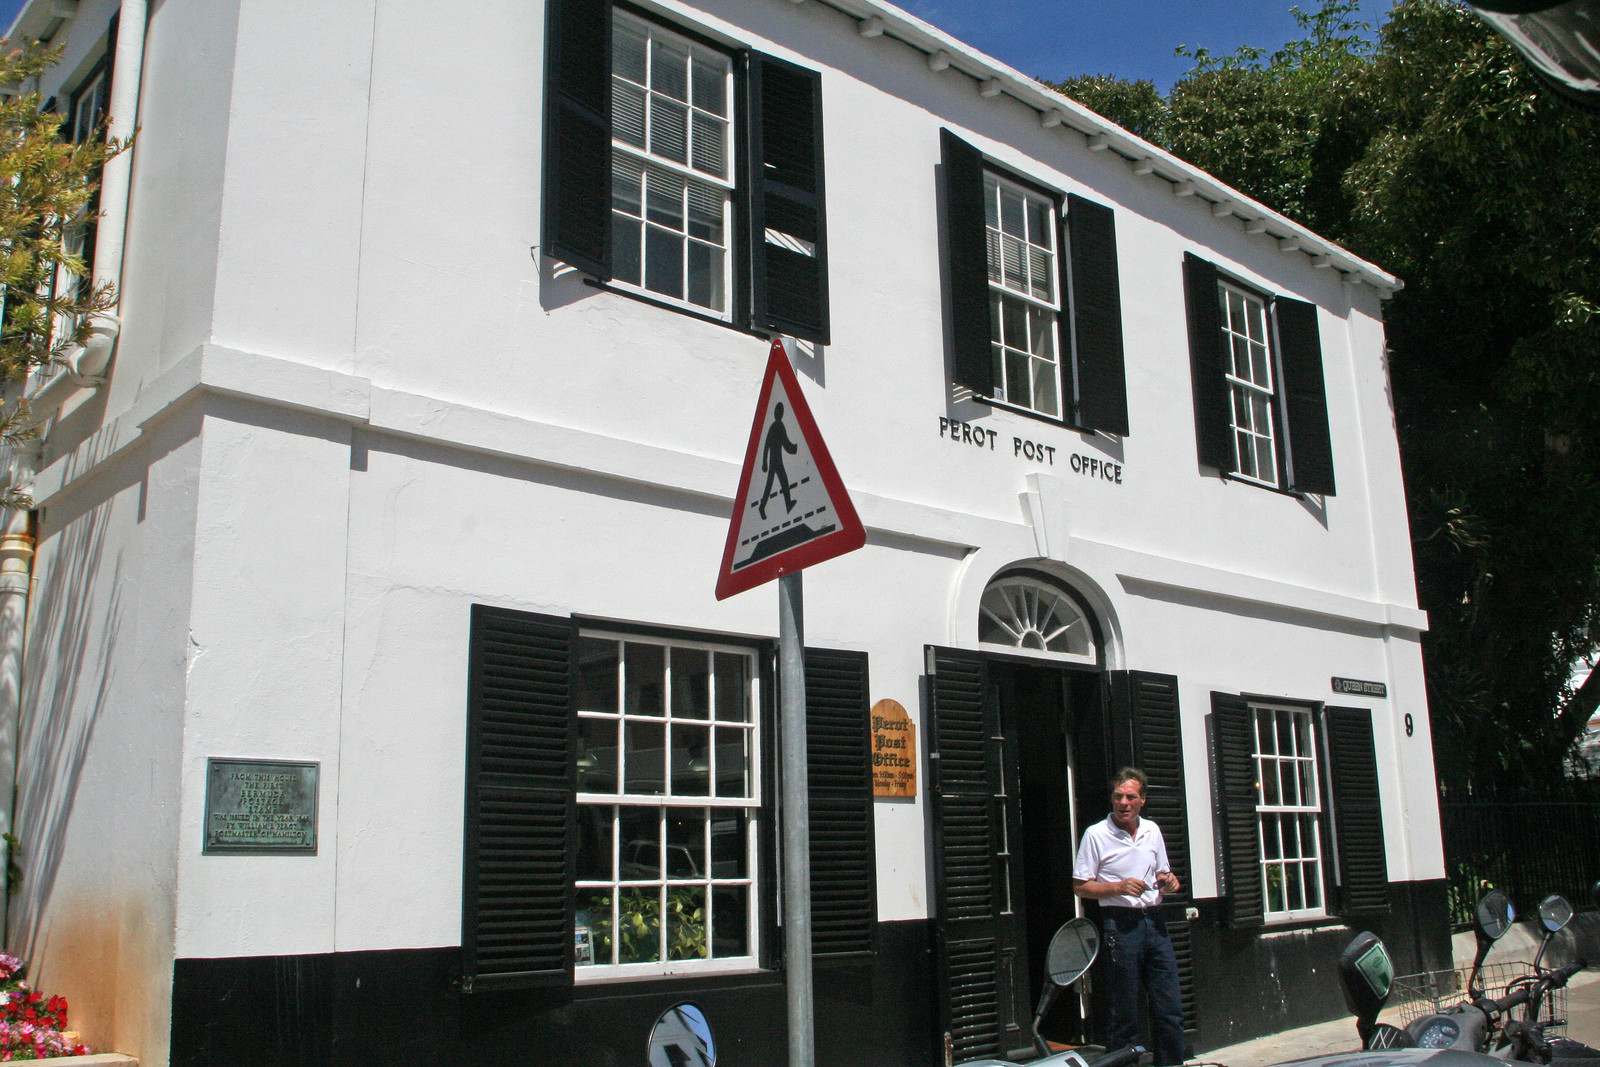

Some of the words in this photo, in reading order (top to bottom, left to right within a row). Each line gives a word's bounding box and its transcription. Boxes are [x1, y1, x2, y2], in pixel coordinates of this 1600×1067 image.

[939, 416, 998, 451] PEROT
[1012, 437, 1056, 466] POST
[1069, 453, 1122, 484] OFFICE
[1343, 680, 1363, 692] QUEEN
[1363, 682, 1384, 695] STREET
[872, 716, 908, 732] Perot
[1404, 713, 1413, 737] 9
[875, 734, 907, 751] Post
[872, 752, 910, 768] Office
[230, 773, 251, 781] FROM
[254, 774, 270, 782] THIS
[274, 774, 297, 782] HOUSE
[263, 782, 283, 790] FIRST
[240, 790, 285, 798] BERMUDA
[242, 798, 283, 806] POSTAGE
[272, 831, 307, 839] HAMILTON
